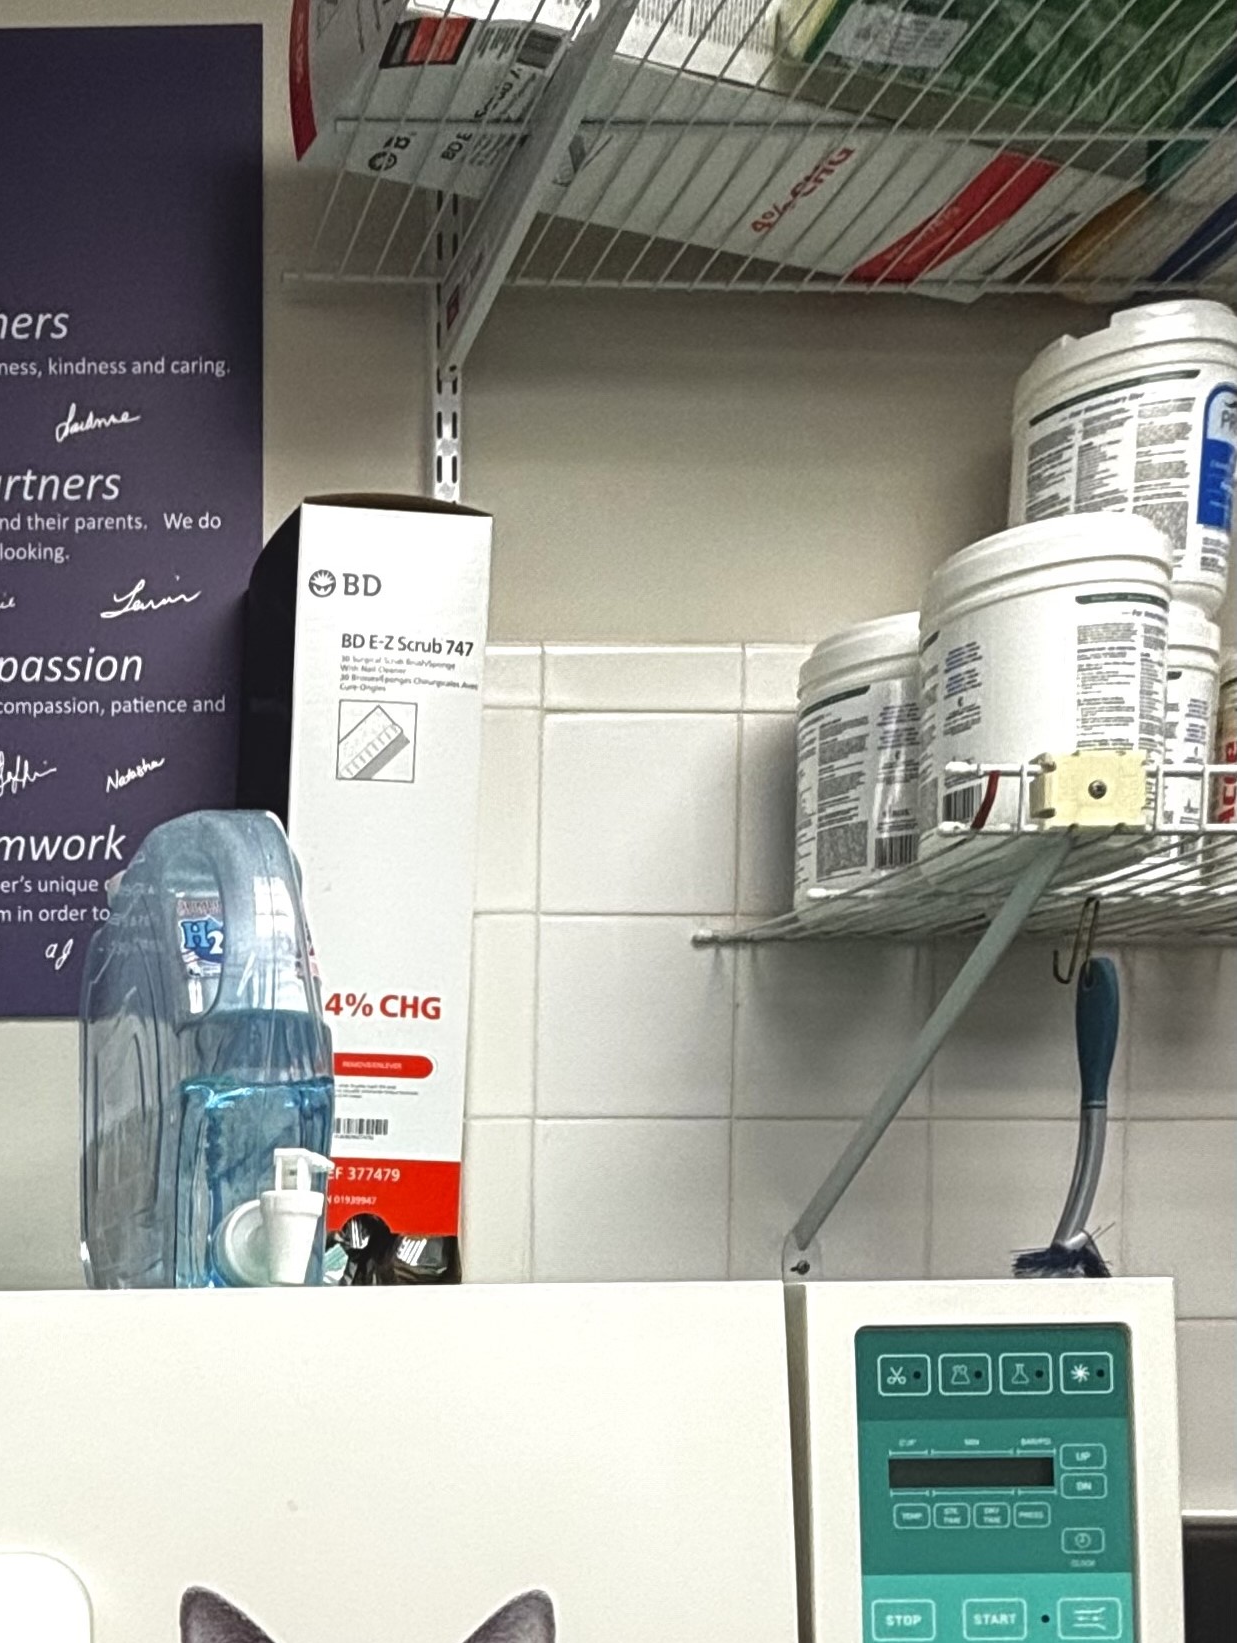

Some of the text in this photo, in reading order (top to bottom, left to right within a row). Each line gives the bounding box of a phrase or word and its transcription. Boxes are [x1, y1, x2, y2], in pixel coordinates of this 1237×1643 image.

[48, 356, 127, 376] kindness
[131, 356, 166, 375] and
[170, 356, 231, 378] caring.
[26, 512, 70, 531] their
[74, 514, 148, 534] parents.
[162, 512, 194, 530] We
[198, 511, 222, 530] do
[0, 542, 70, 564] looking.
[342, 572, 382, 597] BD
[341, 633, 475, 657] BD E-Z Scrub 747
[110, 696, 188, 717] patience
[192, 694, 226, 713] and
[105, 757, 166, 793] Natasha
[37, 875, 99, 896] unique
[17, 905, 33, 923] in
[38, 904, 88, 922] order
[91, 905, 111, 921] to
[325, 993, 441, 1020] 4% CHG
[347, 1166, 401, 1182] 377479
[1075, 1451, 1091, 1461] UP
[885, 1614, 923, 1627] STOP
[973, 1613, 1017, 1626] START
